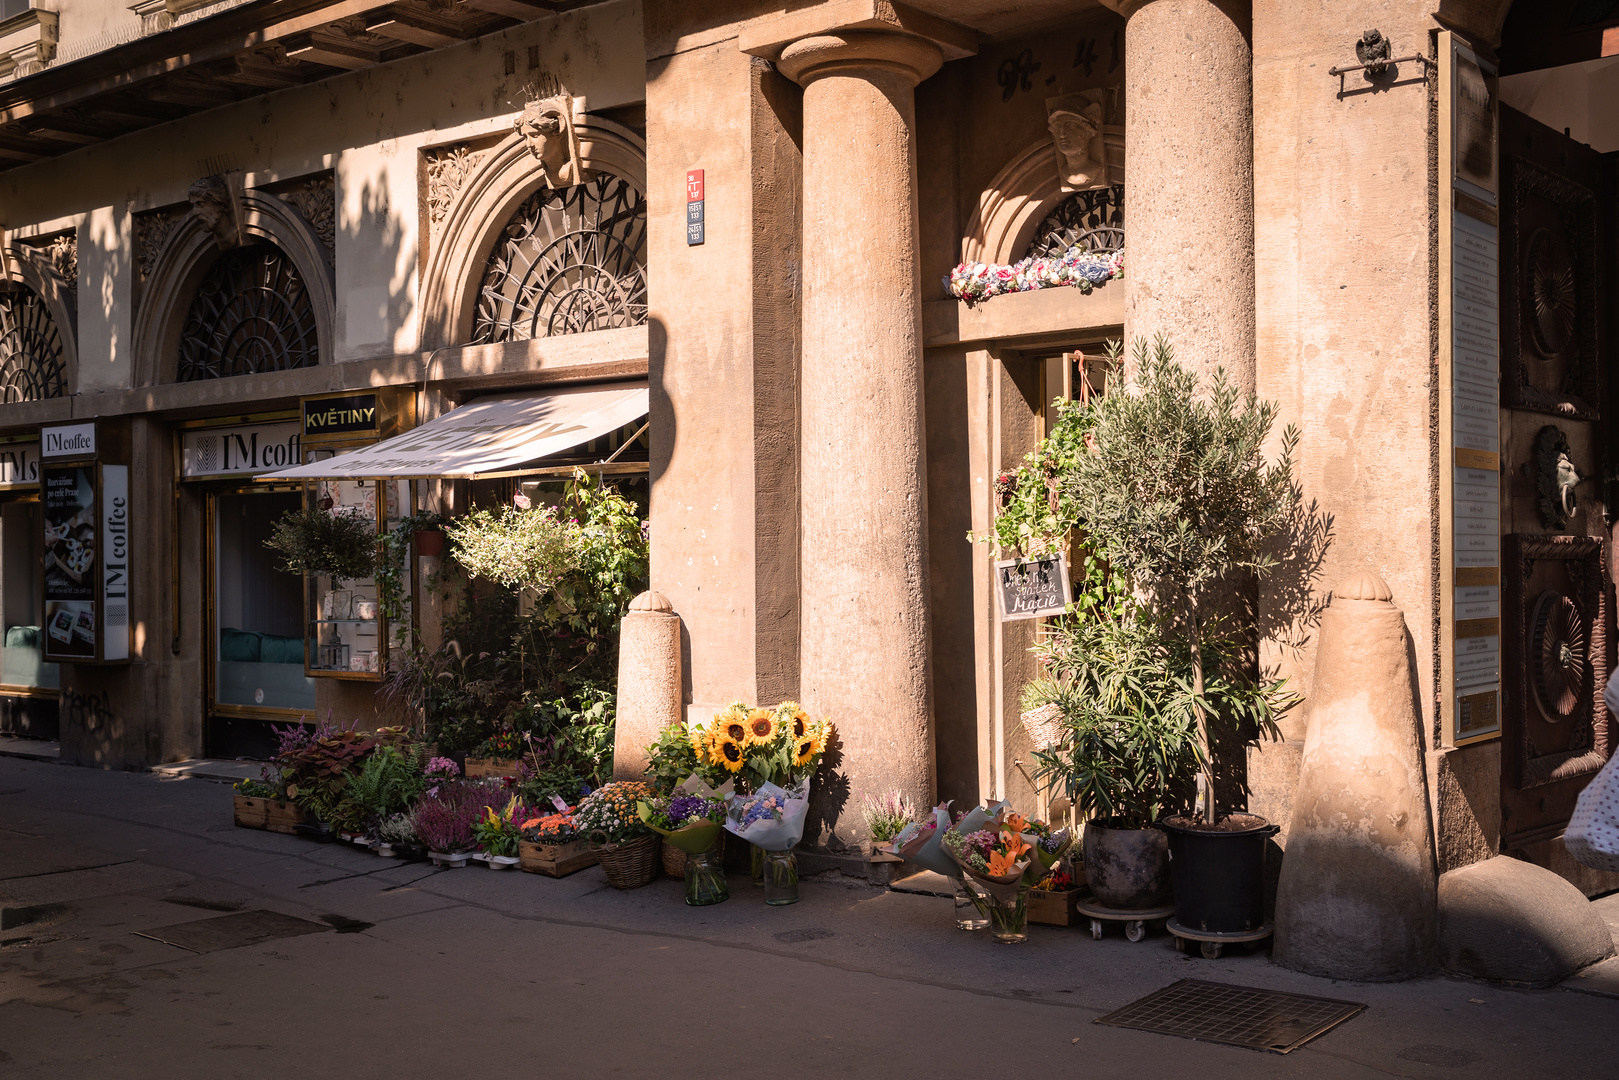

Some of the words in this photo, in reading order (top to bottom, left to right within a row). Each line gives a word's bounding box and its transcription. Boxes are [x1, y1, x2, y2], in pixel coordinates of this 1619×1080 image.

[306, 407, 375, 428] KVĚTINY
[46, 433, 63, 452] I'M
[63, 433, 91, 450] coffee
[221, 432, 260, 471] I'M
[107, 496, 126, 559] coffee
[105, 562, 127, 600] I'M
